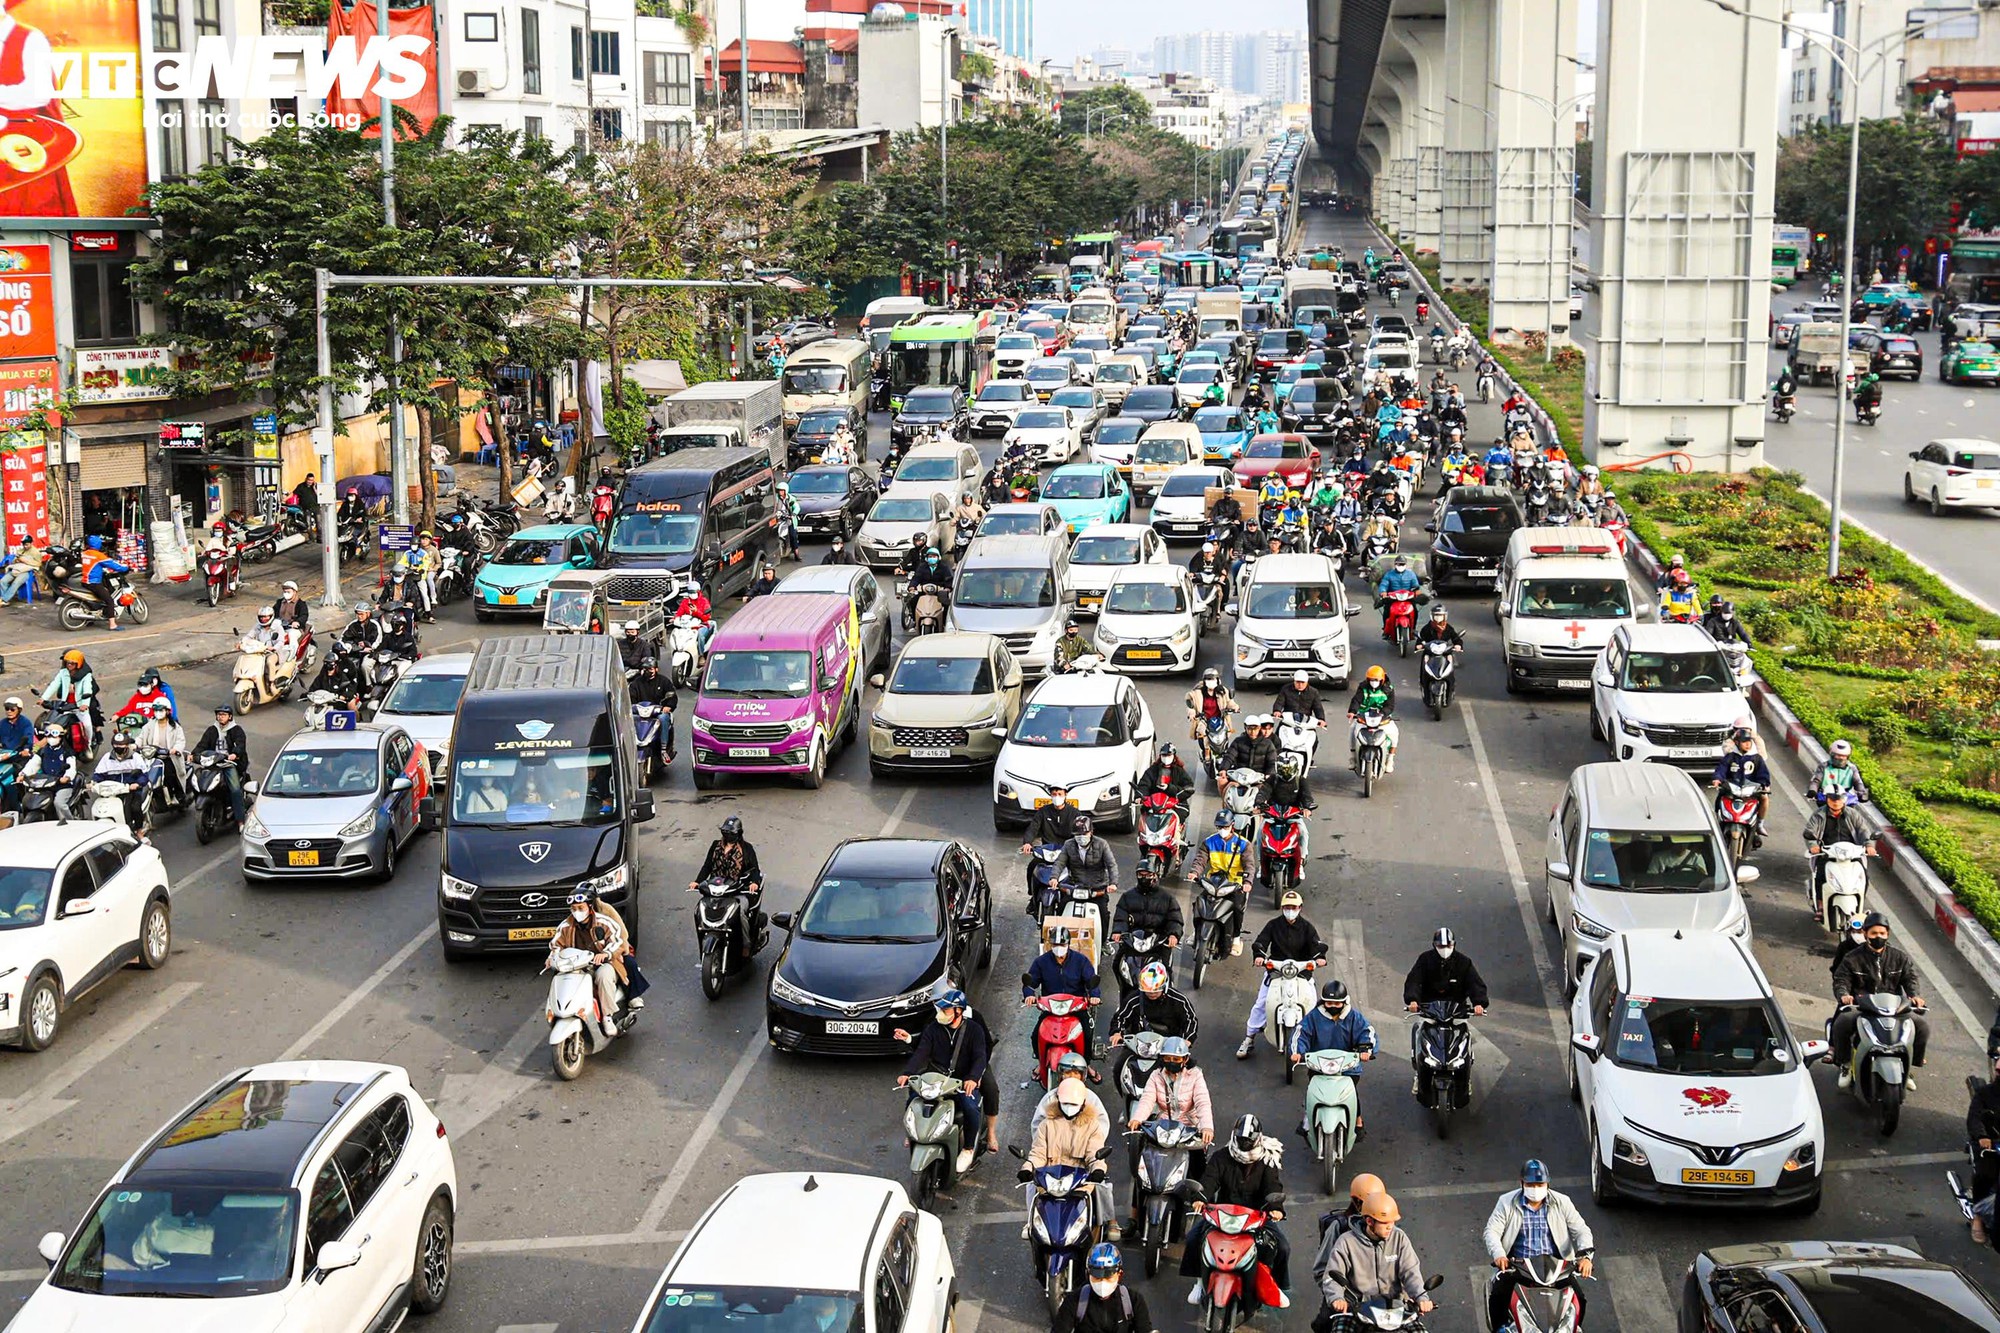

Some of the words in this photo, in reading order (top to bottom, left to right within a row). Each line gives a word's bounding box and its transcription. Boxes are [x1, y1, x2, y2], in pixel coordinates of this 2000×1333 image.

[103, 352, 111, 361] TY
[23, 369, 36, 378] XE
[5, 455, 27, 470] SỬA
[10, 480, 25, 492] XE
[7, 499, 30, 513] MÁY
[636, 502, 682, 512] halan
[13, 524, 28, 535] XE
[729, 549, 745, 566] halan
[332, 714, 348, 729] G7
[1622, 1033, 1643, 1042] TAXI
[1688, 1171, 1749, 1183] 29E-194.56
